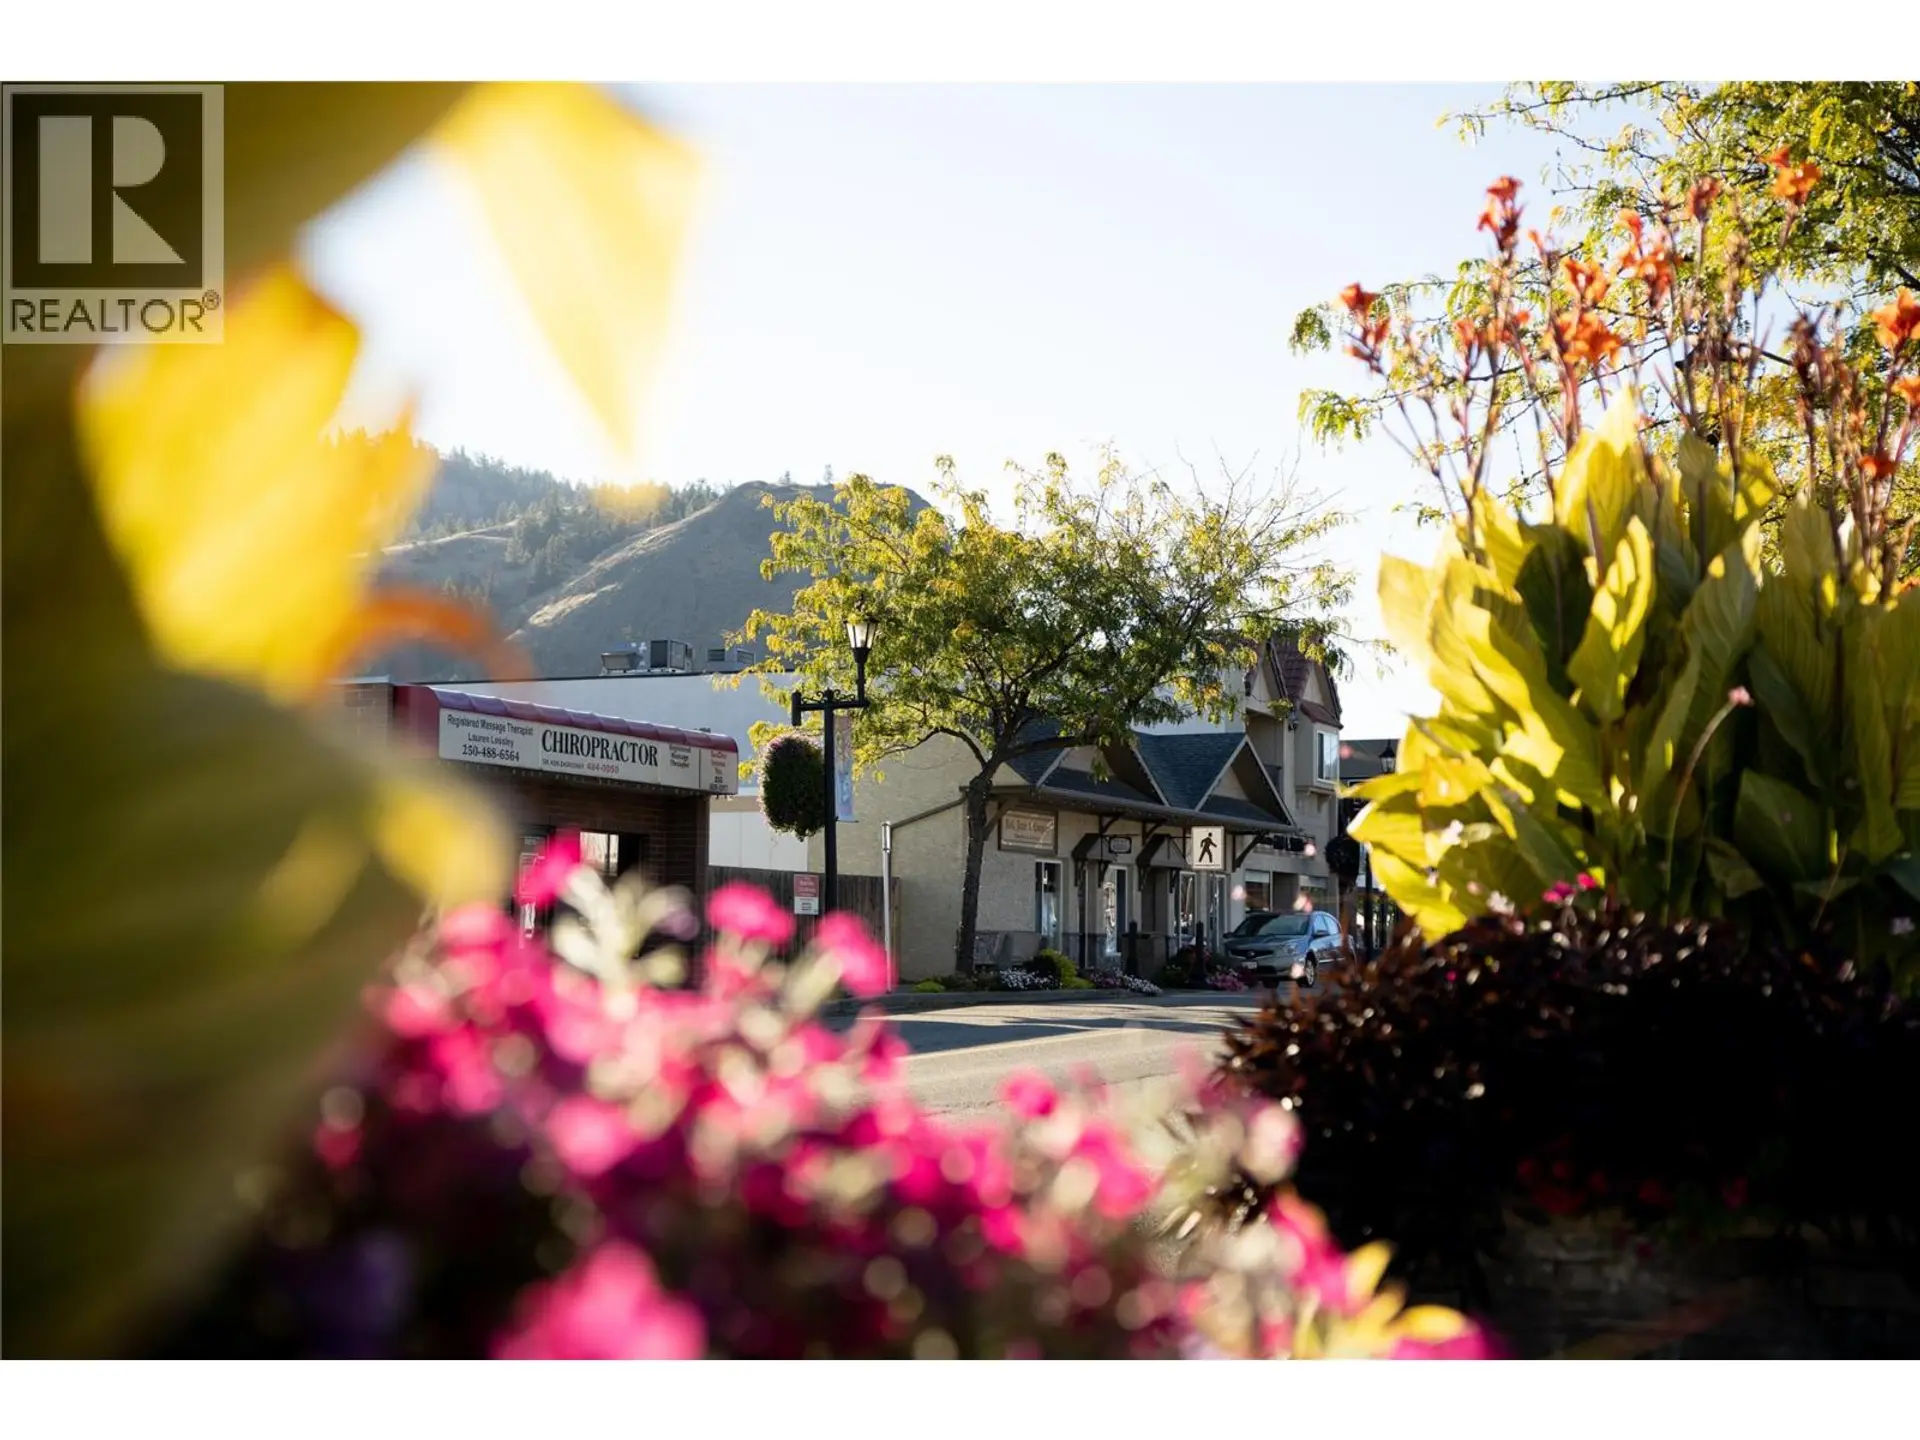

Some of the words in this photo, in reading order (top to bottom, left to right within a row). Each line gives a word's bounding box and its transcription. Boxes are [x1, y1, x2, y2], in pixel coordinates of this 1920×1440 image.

[447, 714, 480, 728] Registered
[480, 719, 506, 734] Massage
[507, 722, 534, 736] Therapist
[462, 744, 520, 762] 250-488-6564
[541, 729, 658, 767] CHIROPRACTOR
